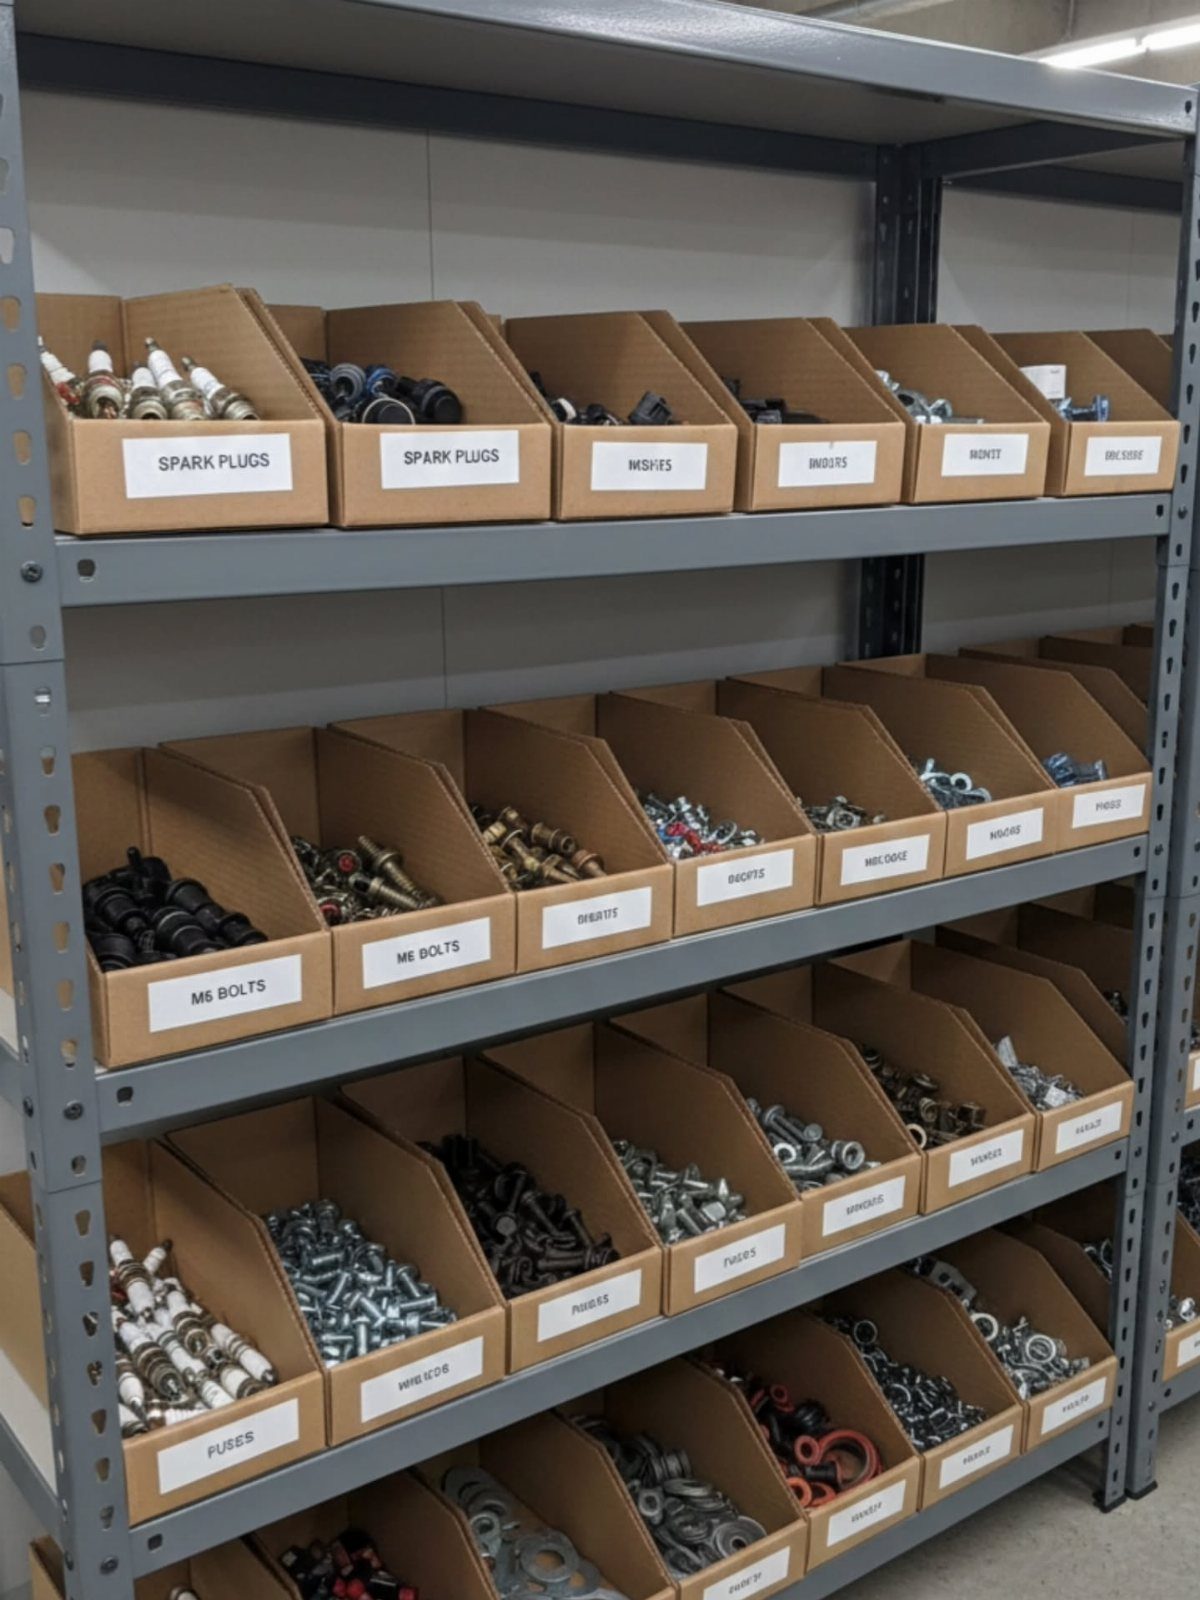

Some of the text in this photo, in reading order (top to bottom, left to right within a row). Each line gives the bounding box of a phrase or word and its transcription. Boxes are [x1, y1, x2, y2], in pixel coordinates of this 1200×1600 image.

[158, 452, 271, 472] SPARK PLUGS
[403, 448, 500, 466] SPARK PLUGS
[418, 939, 461, 960] BOLTS
[190, 978, 267, 1006] M6 BOLTS
